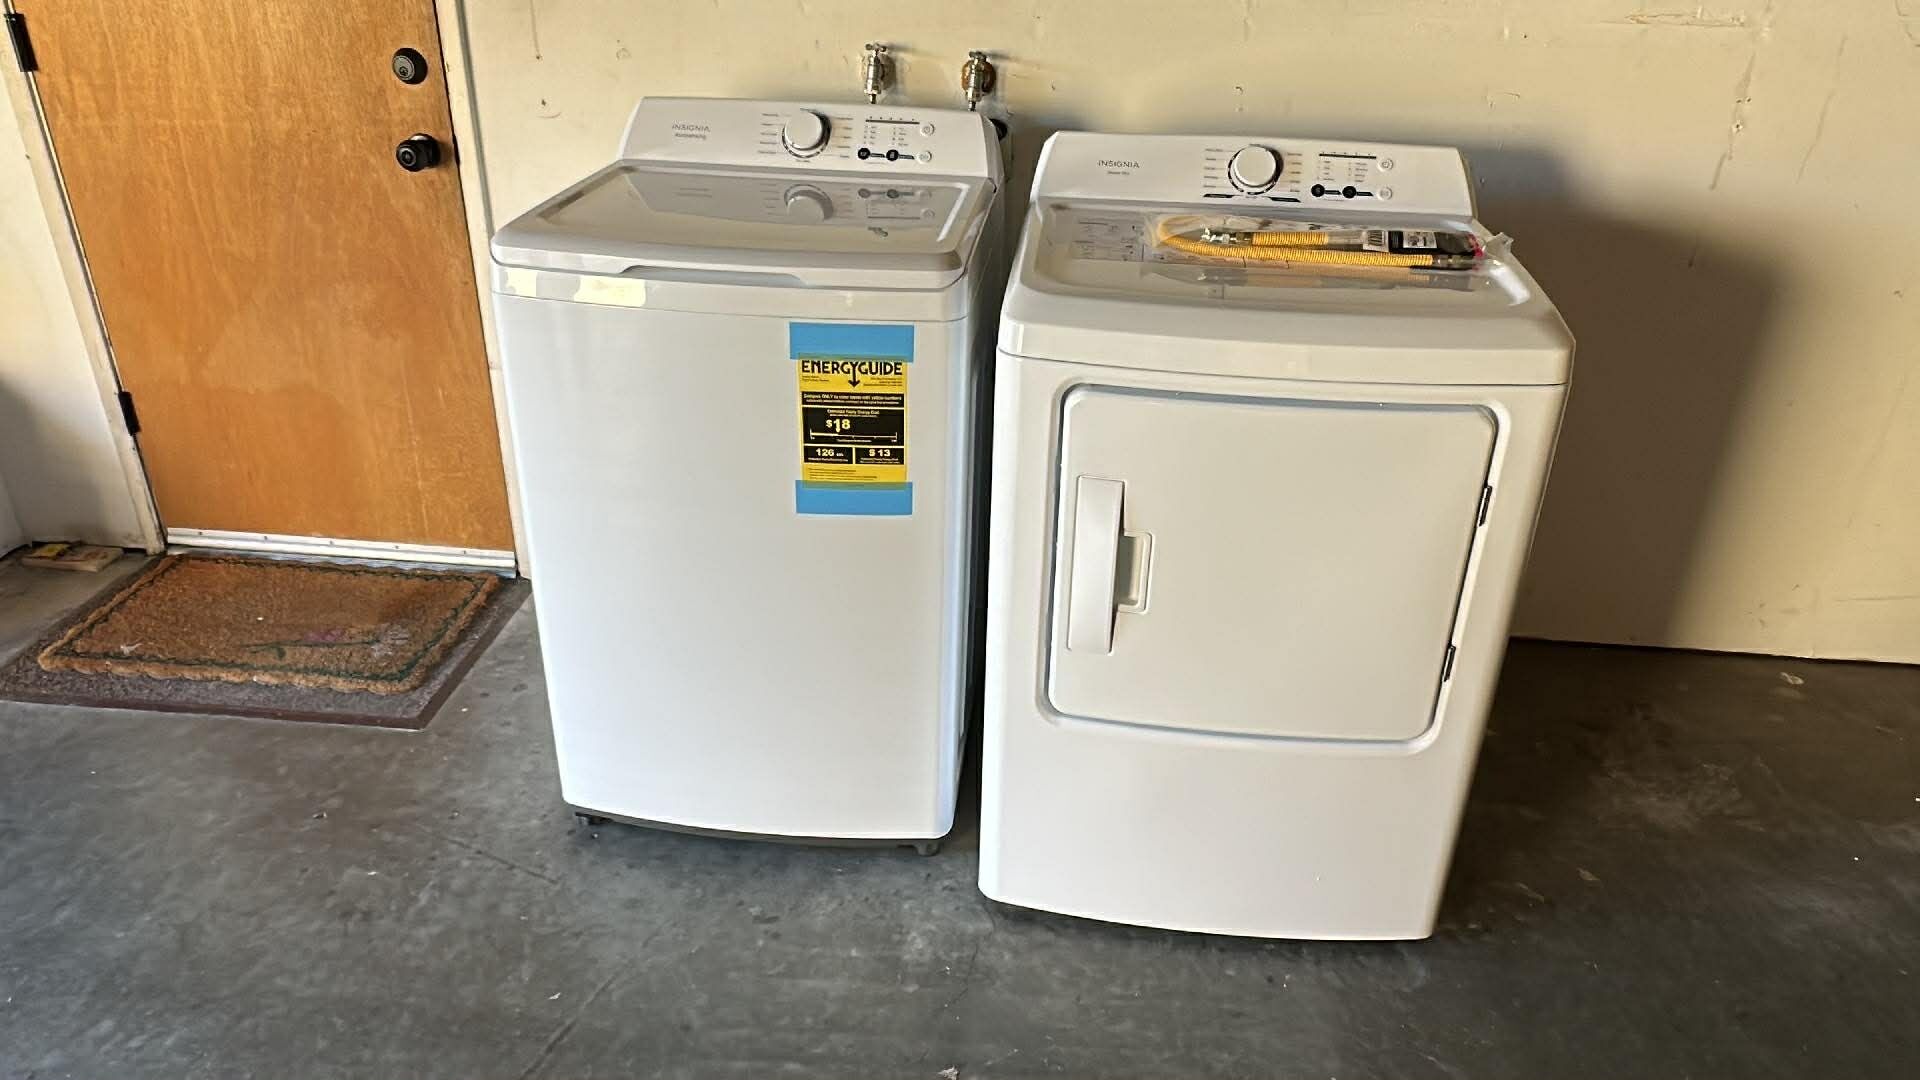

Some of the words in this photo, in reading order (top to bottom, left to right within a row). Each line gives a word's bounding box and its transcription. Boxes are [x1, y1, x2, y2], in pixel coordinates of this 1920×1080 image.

[671, 123, 711, 133] INSIGNIA
[1098, 160, 1140, 169] INSIGNIA
[801, 360, 903, 376] ENERGYGUIDE
[825, 419, 851, 433] $18
[815, 448, 835, 457] 126
